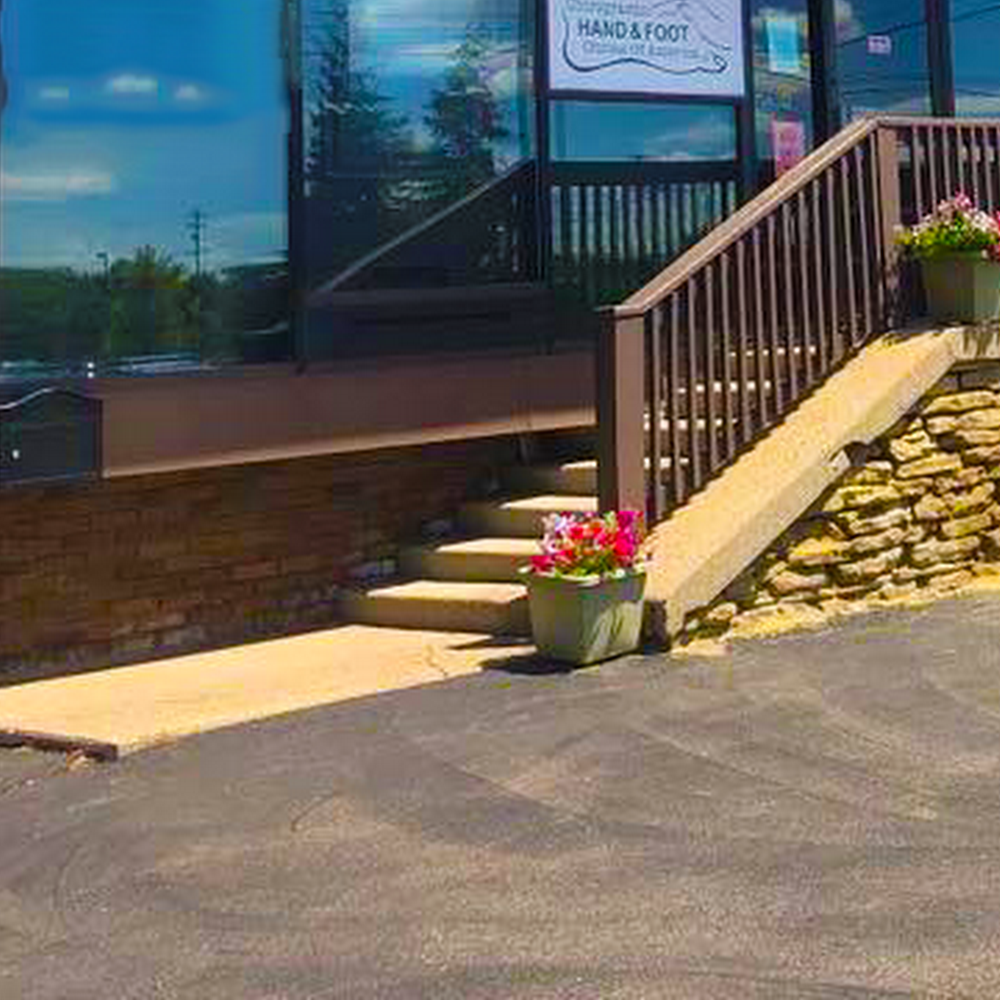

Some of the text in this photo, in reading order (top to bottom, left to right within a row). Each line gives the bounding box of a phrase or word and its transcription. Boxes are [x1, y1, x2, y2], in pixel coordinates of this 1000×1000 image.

[577, 18, 689, 43] HAND & FOOT
